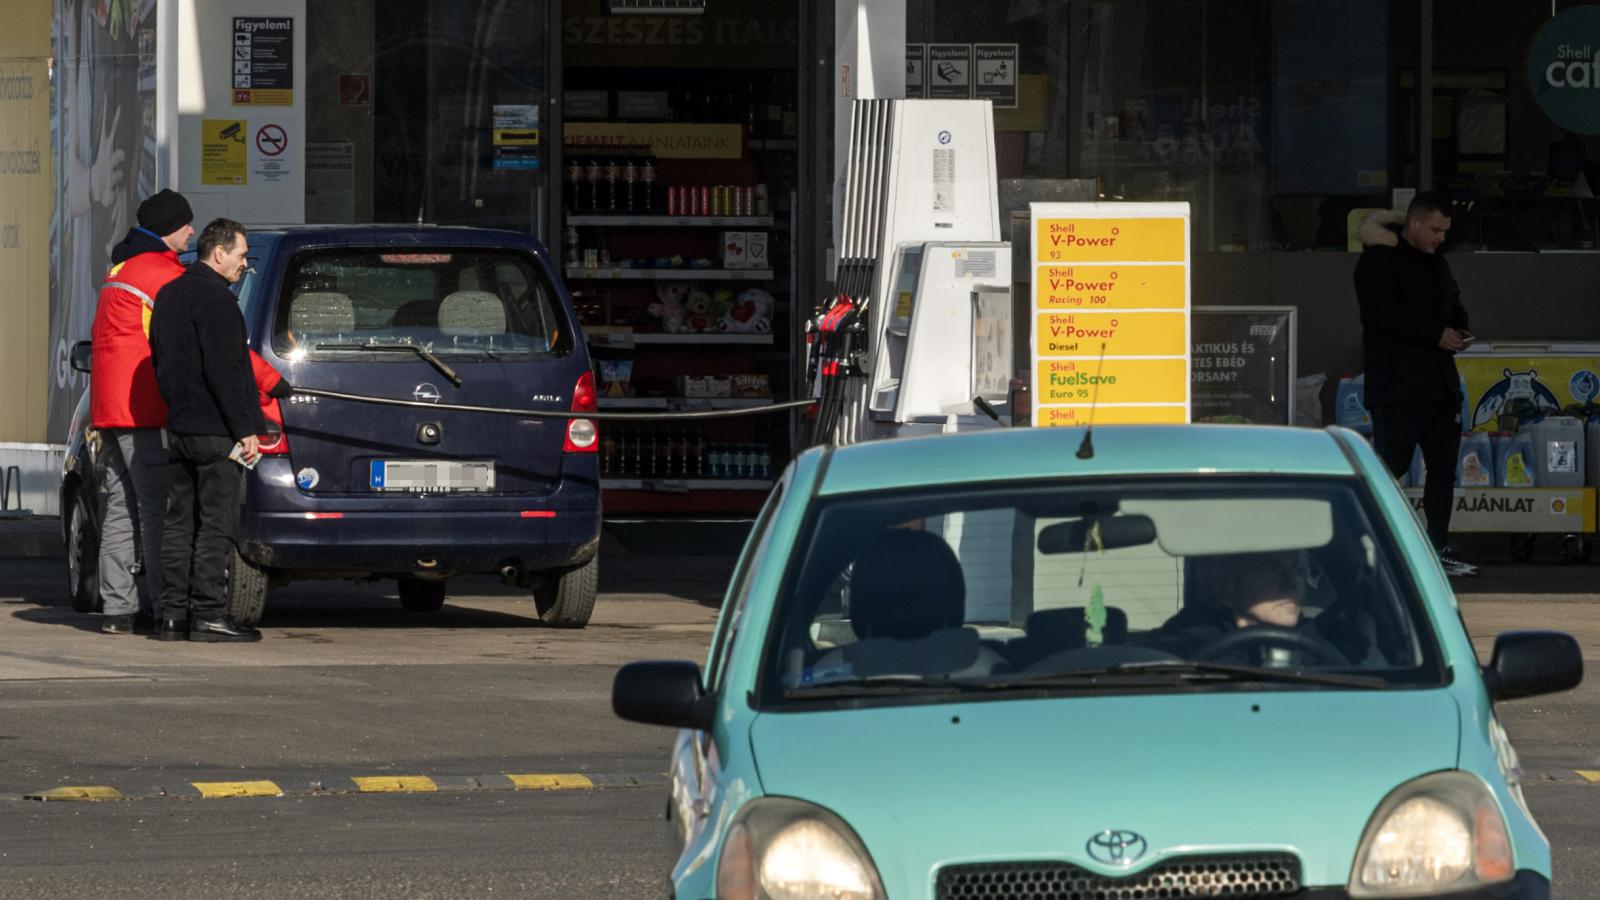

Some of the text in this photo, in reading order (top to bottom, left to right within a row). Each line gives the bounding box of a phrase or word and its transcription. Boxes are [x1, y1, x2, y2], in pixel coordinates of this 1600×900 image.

[235, 19, 291, 32] Figyelem!
[564, 18, 704, 45] SZESZES
[1557, 44, 1591, 59] Shell
[1050, 223, 1075, 233] Shell
[1050, 235, 1116, 247] V-Power
[1049, 251, 1061, 260] 95
[1049, 268, 1073, 277] Shell
[1049, 279, 1115, 291] V-Power
[1048, 295, 1106, 306] Racing 100
[1049, 315, 1075, 325] Shell
[1050, 327, 1115, 339] V-Power
[1048, 342, 1078, 351] Diesel
[1241, 339, 1255, 354] ÉS
[1215, 354, 1246, 368] EBÉD
[1050, 362, 1075, 372] Shell
[1049, 372, 1117, 385] FuelSave
[1049, 389, 1089, 399] Euro 95
[290, 395, 320, 405] OPEL
[1049, 410, 1075, 420] Shell
[1456, 493, 1535, 513] AJÁNLAT
